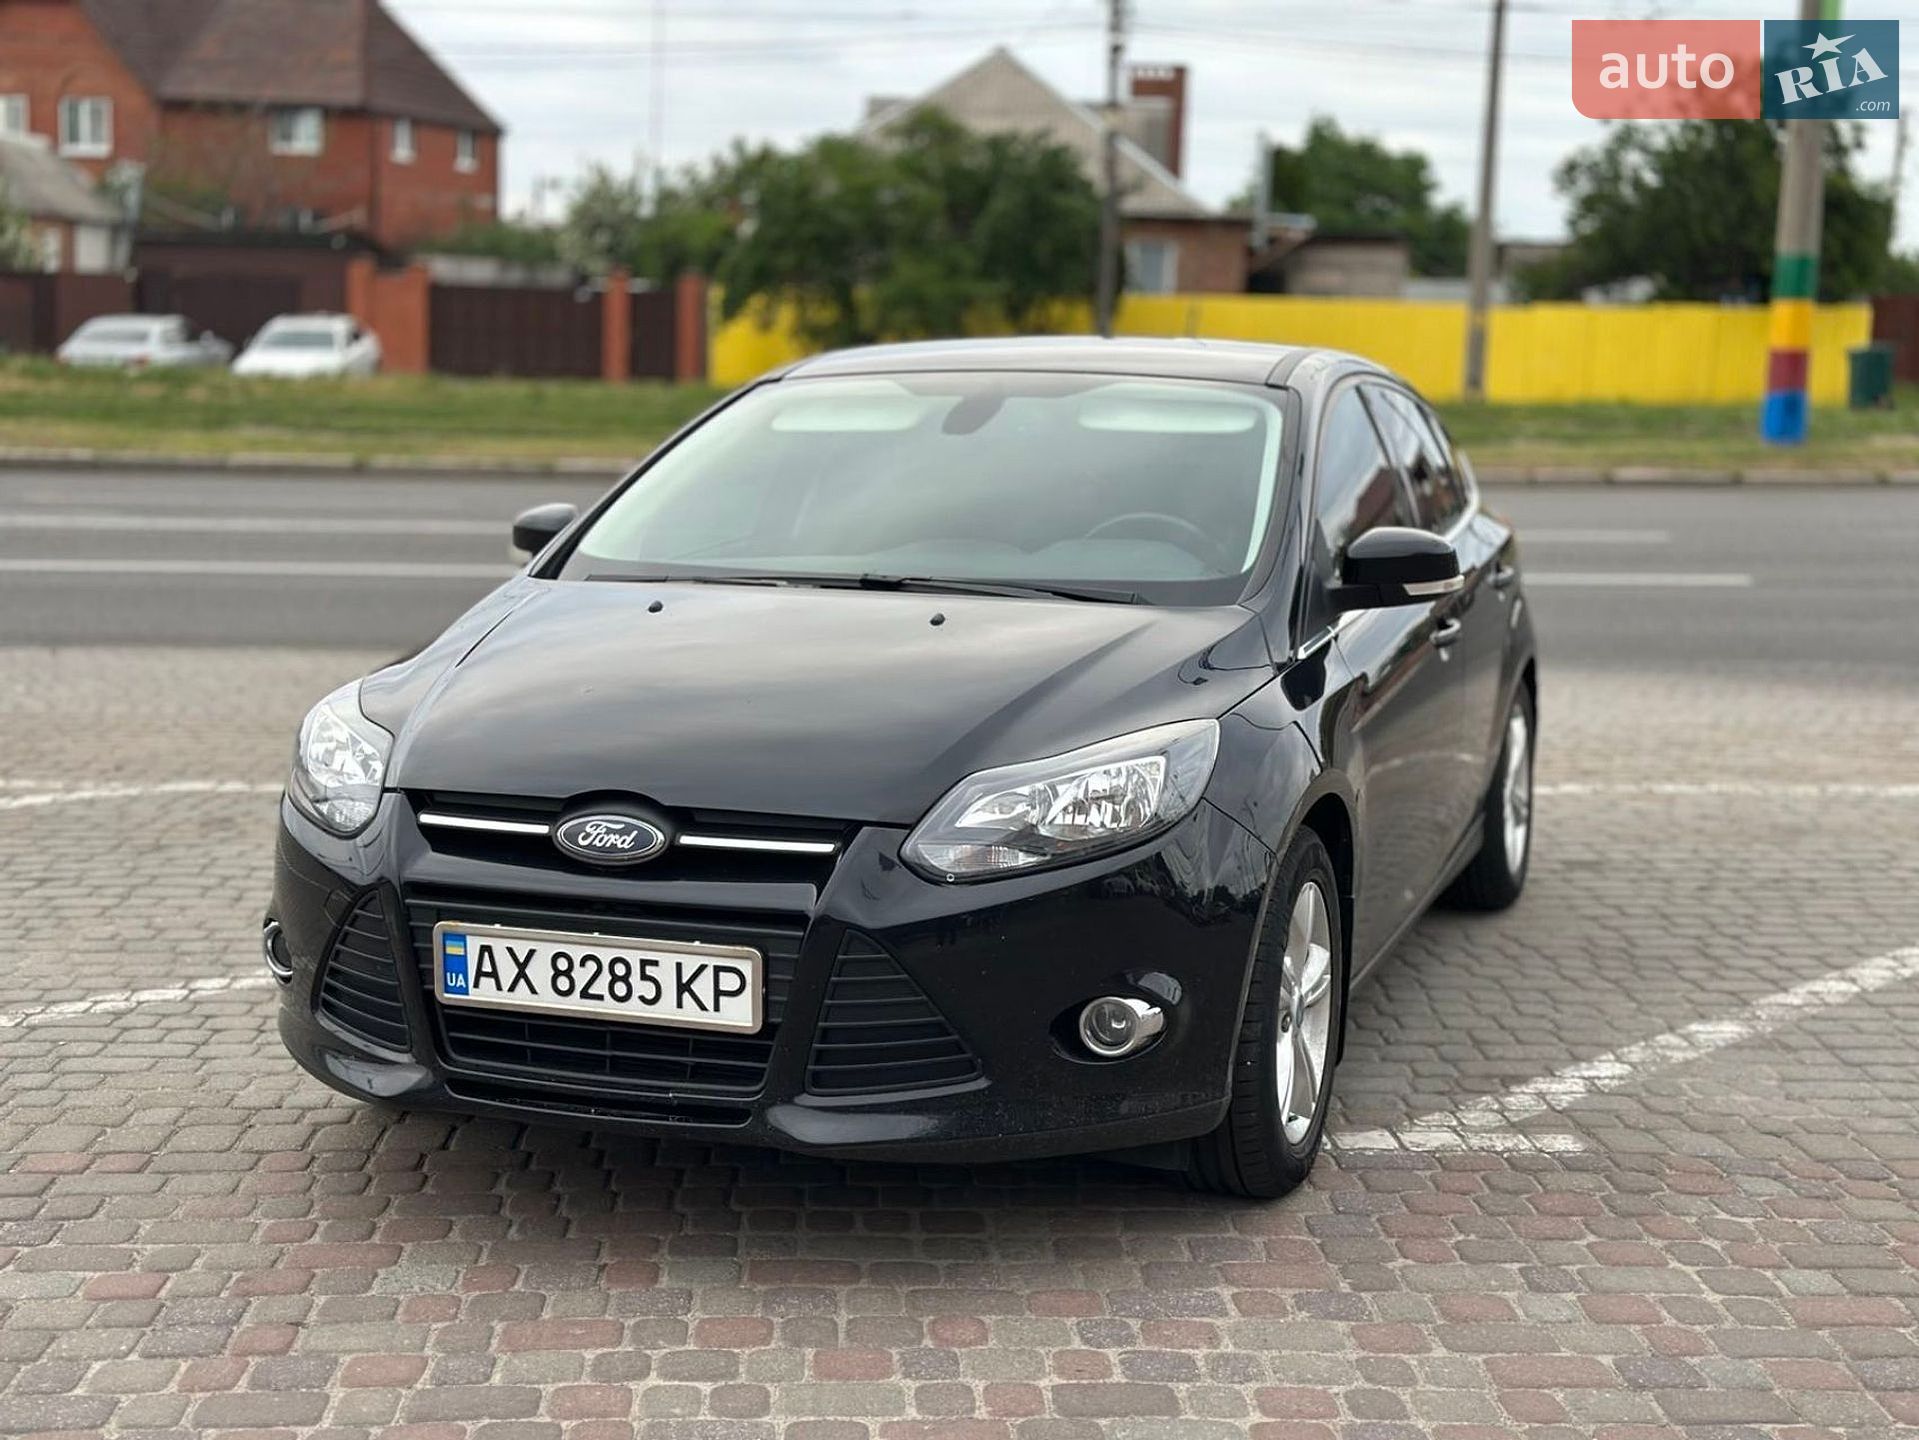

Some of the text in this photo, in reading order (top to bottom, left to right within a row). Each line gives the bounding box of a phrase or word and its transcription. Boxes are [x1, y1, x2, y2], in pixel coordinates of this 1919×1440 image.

[577, 821, 638, 849] Ford
[446, 971, 466, 989] UA
[472, 944, 747, 1013] AX 8285 KP
